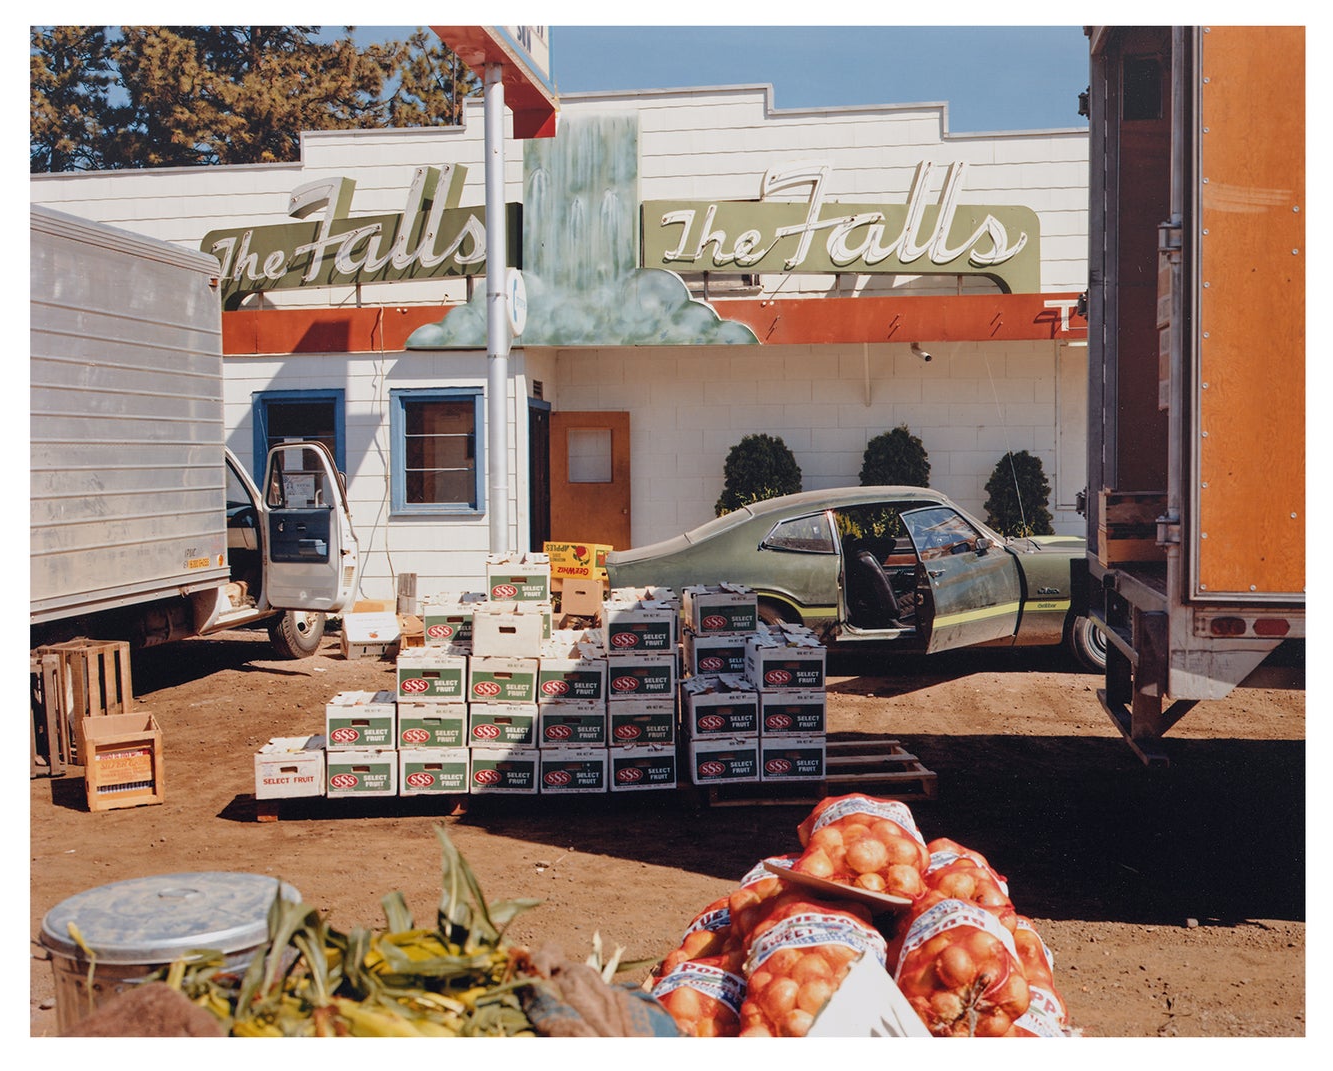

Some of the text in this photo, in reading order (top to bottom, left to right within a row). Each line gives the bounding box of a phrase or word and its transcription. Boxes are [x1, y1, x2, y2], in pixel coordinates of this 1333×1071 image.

[661, 159, 1028, 270] The Falls
[212, 163, 487, 283] The Falls
[493, 585, 516, 597] SSS
[702, 616, 727, 628] SSS
[428, 625, 452, 637] SSS
[612, 633, 638, 646] SSS
[699, 658, 724, 670] SSS
[612, 677, 639, 690] SSS
[765, 671, 792, 684] SSS
[402, 679, 429, 692] SSS
[474, 682, 500, 696] SSS
[542, 681, 569, 694] SSS
[699, 716, 725, 729] SSS
[766, 715, 792, 728] SSS
[331, 729, 359, 742] SSS
[403, 729, 430, 743] SSS
[473, 725, 500, 738] SSS
[545, 726, 572, 739] SSS
[615, 726, 641, 739] SSS
[699, 762, 725, 775] SSS
[765, 760, 792, 773] SSS
[263, 777, 290, 785] SELECT
[331, 774, 358, 787] SSS
[407, 773, 434, 787] SSS
[474, 771, 501, 784] SSS
[544, 772, 571, 785] SSS
[617, 768, 642, 781] SSS
